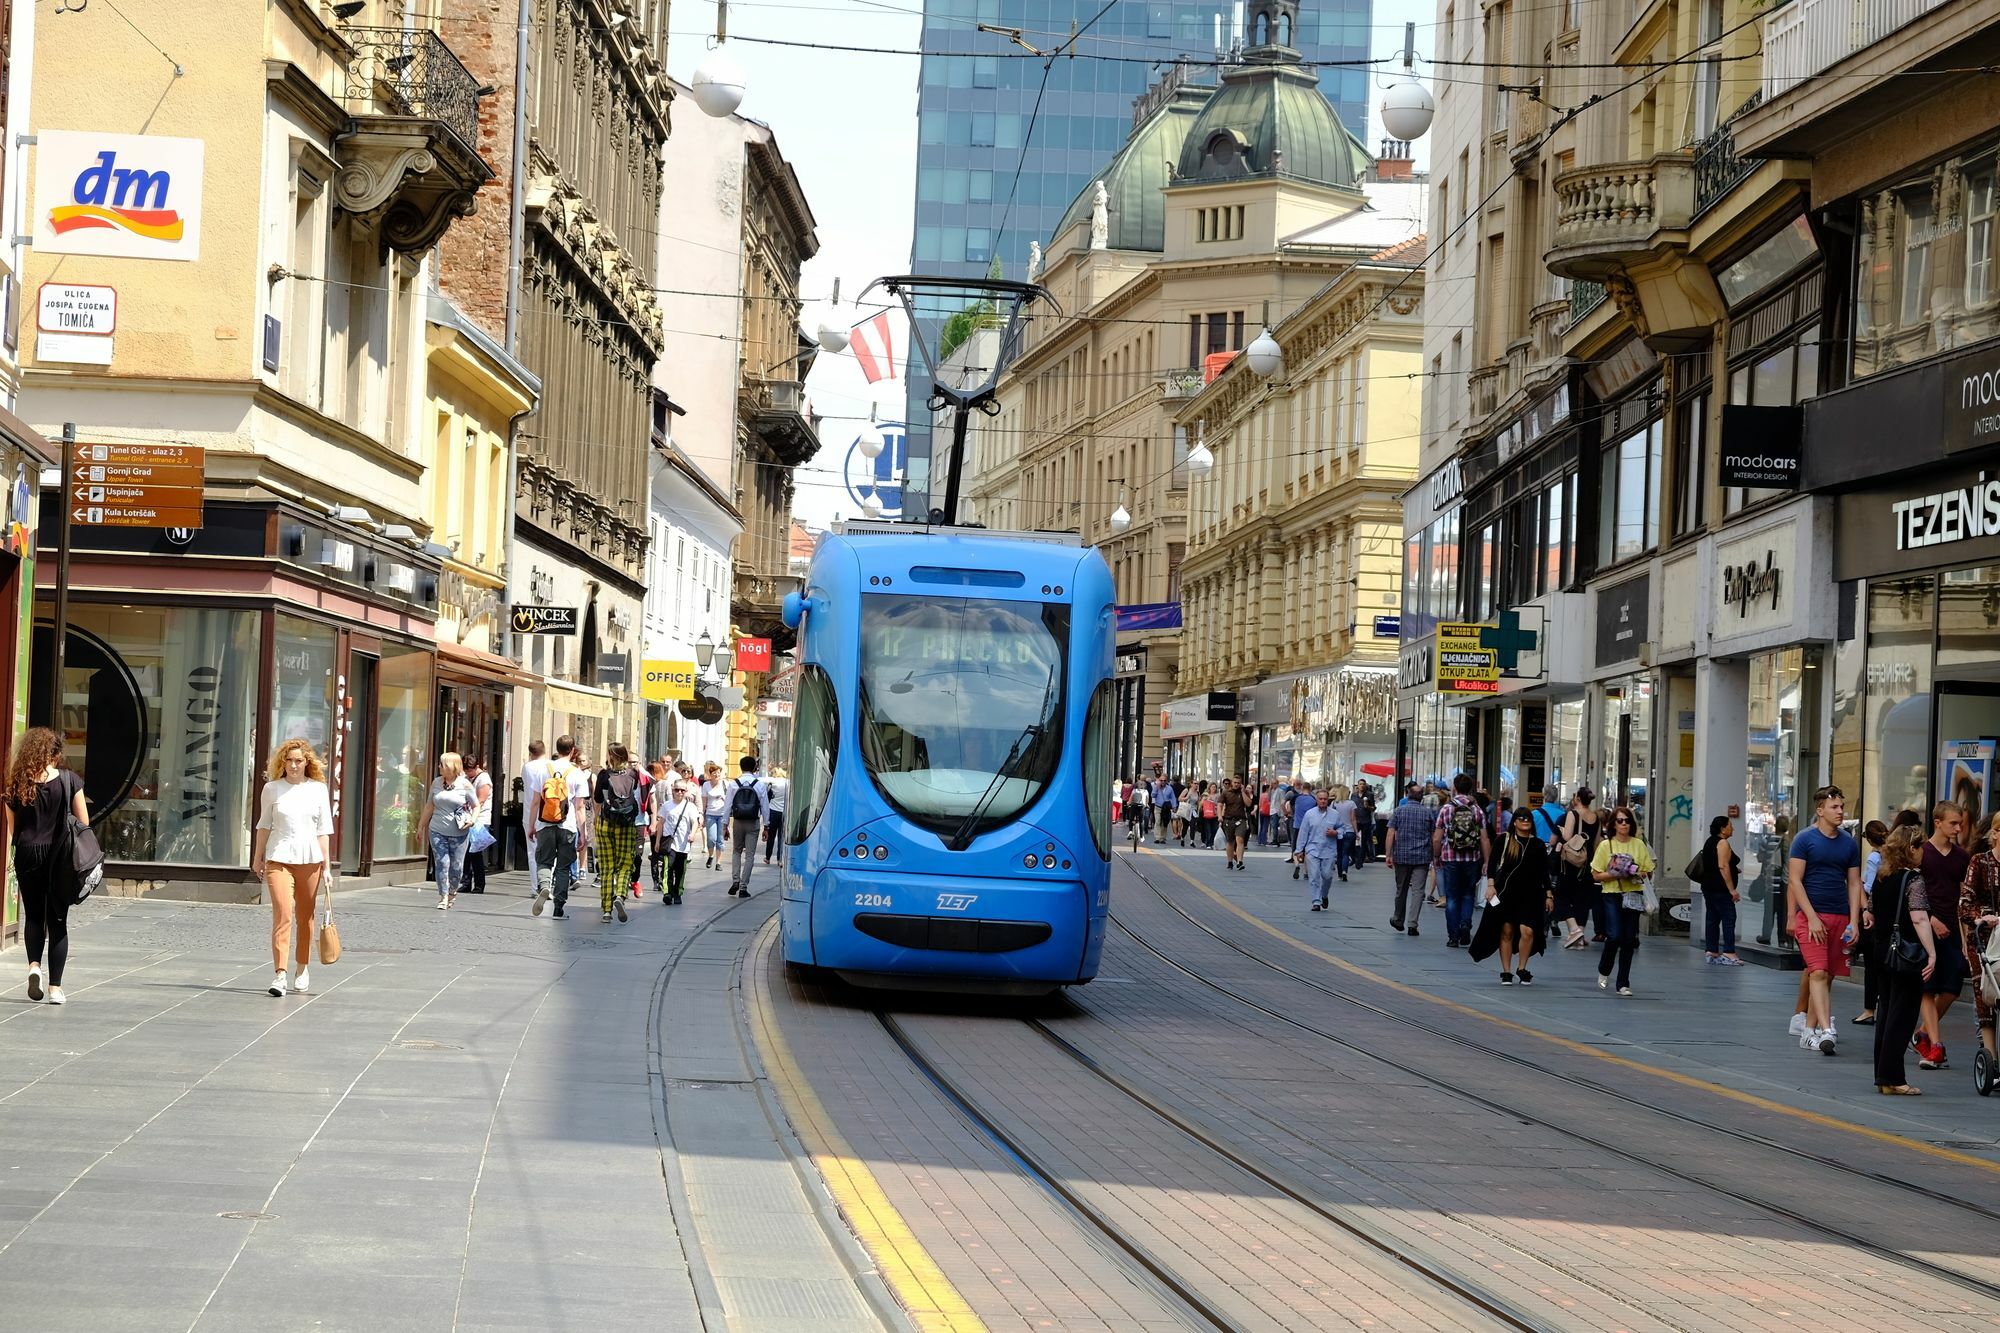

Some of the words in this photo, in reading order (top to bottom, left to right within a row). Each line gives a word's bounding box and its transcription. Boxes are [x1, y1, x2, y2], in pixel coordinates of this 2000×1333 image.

[72, 150, 171, 210] dm
[64, 290, 91, 298] ULICA
[45, 301, 73, 309] JOSIPA
[78, 302, 110, 311] EUGENA
[109, 446, 130, 454] Tunel
[131, 446, 146, 455] Grič
[153, 447, 168, 455] ulaz
[1725, 453, 1797, 470] modoars
[107, 467, 131, 476] Gornji
[132, 467, 152, 476] Grad
[1733, 472, 1763, 480] INTERIOR
[1763, 472, 1788, 481] DESIGN
[106, 488, 144, 497] Uspinjača
[123, 509, 157, 518] Lotrščak
[518, 607, 570, 622] VINCEK
[880, 628, 906, 657] 17
[1440, 641, 1477, 650] EXCHANGE
[740, 643, 767, 655] högl
[646, 671, 692, 683] OFFICE
[1439, 667, 1466, 677] OTKUP
[1466, 668, 1490, 678] ZLATA
[1454, 680, 1489, 690] Ukoliko
[182, 666, 222, 821] MANGO
[854, 893, 892, 907] 2204
[936, 893, 978, 911] ZET
